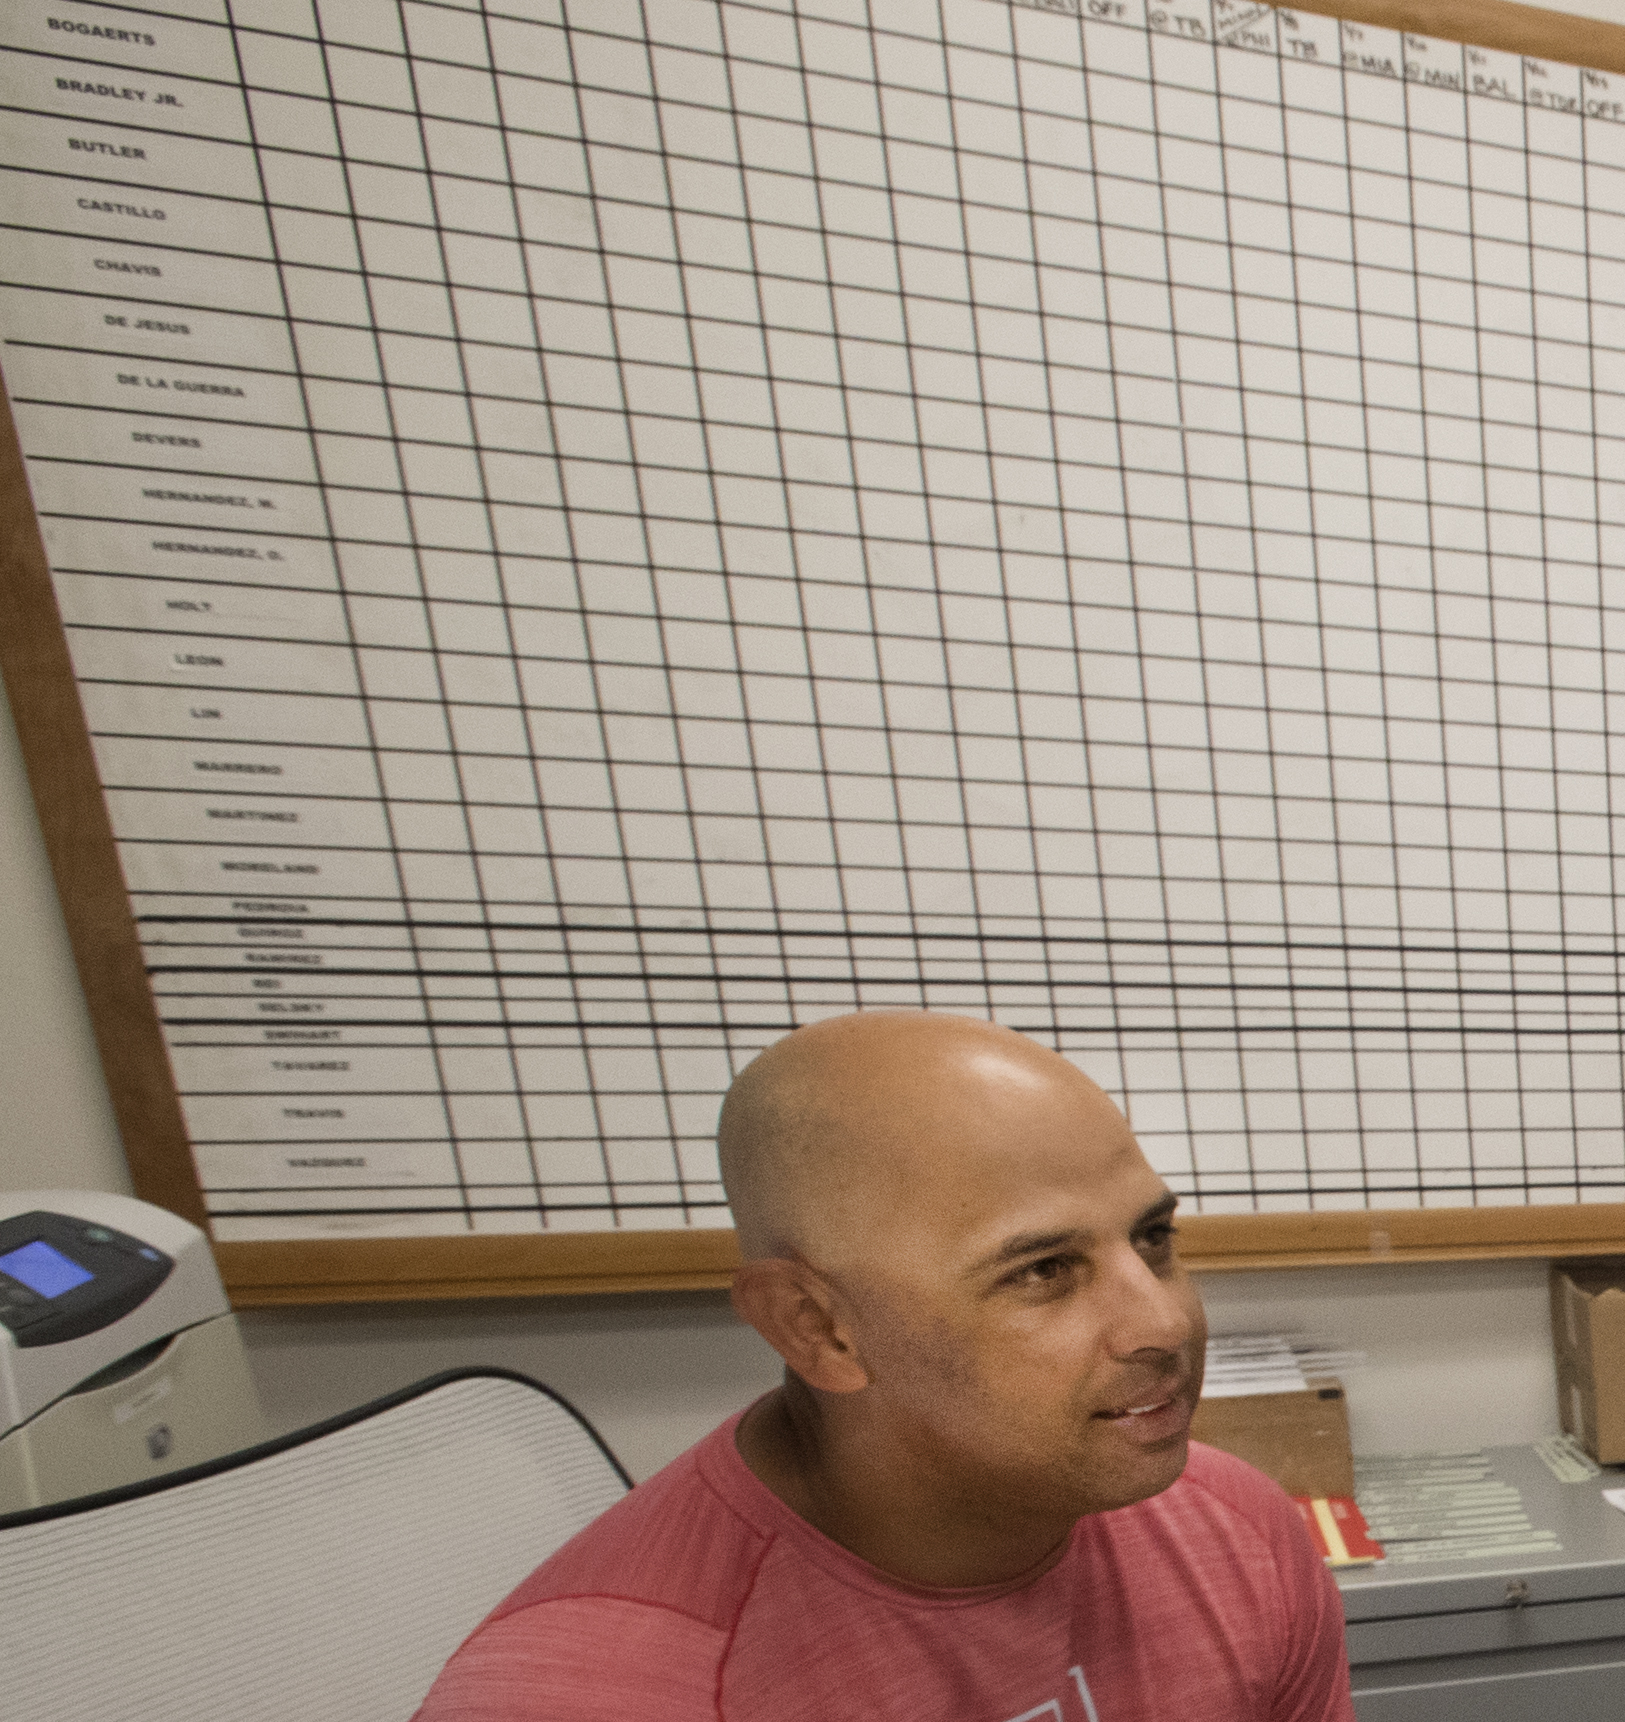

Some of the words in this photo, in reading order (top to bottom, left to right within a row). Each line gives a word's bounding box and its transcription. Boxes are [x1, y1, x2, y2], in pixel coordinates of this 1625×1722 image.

[47, 17, 155, 46] BOGAERTS
[55, 77, 147, 102] BRADLEY
[68, 137, 147, 160] BUTLER
[77, 198, 167, 221] CASTILLO
[94, 258, 161, 278] CHAVIS
[104, 314, 128, 328] DE
[134, 318, 190, 335] JESUS
[117, 373, 142, 386] DE
[174, 379, 245, 398] GUERRA
